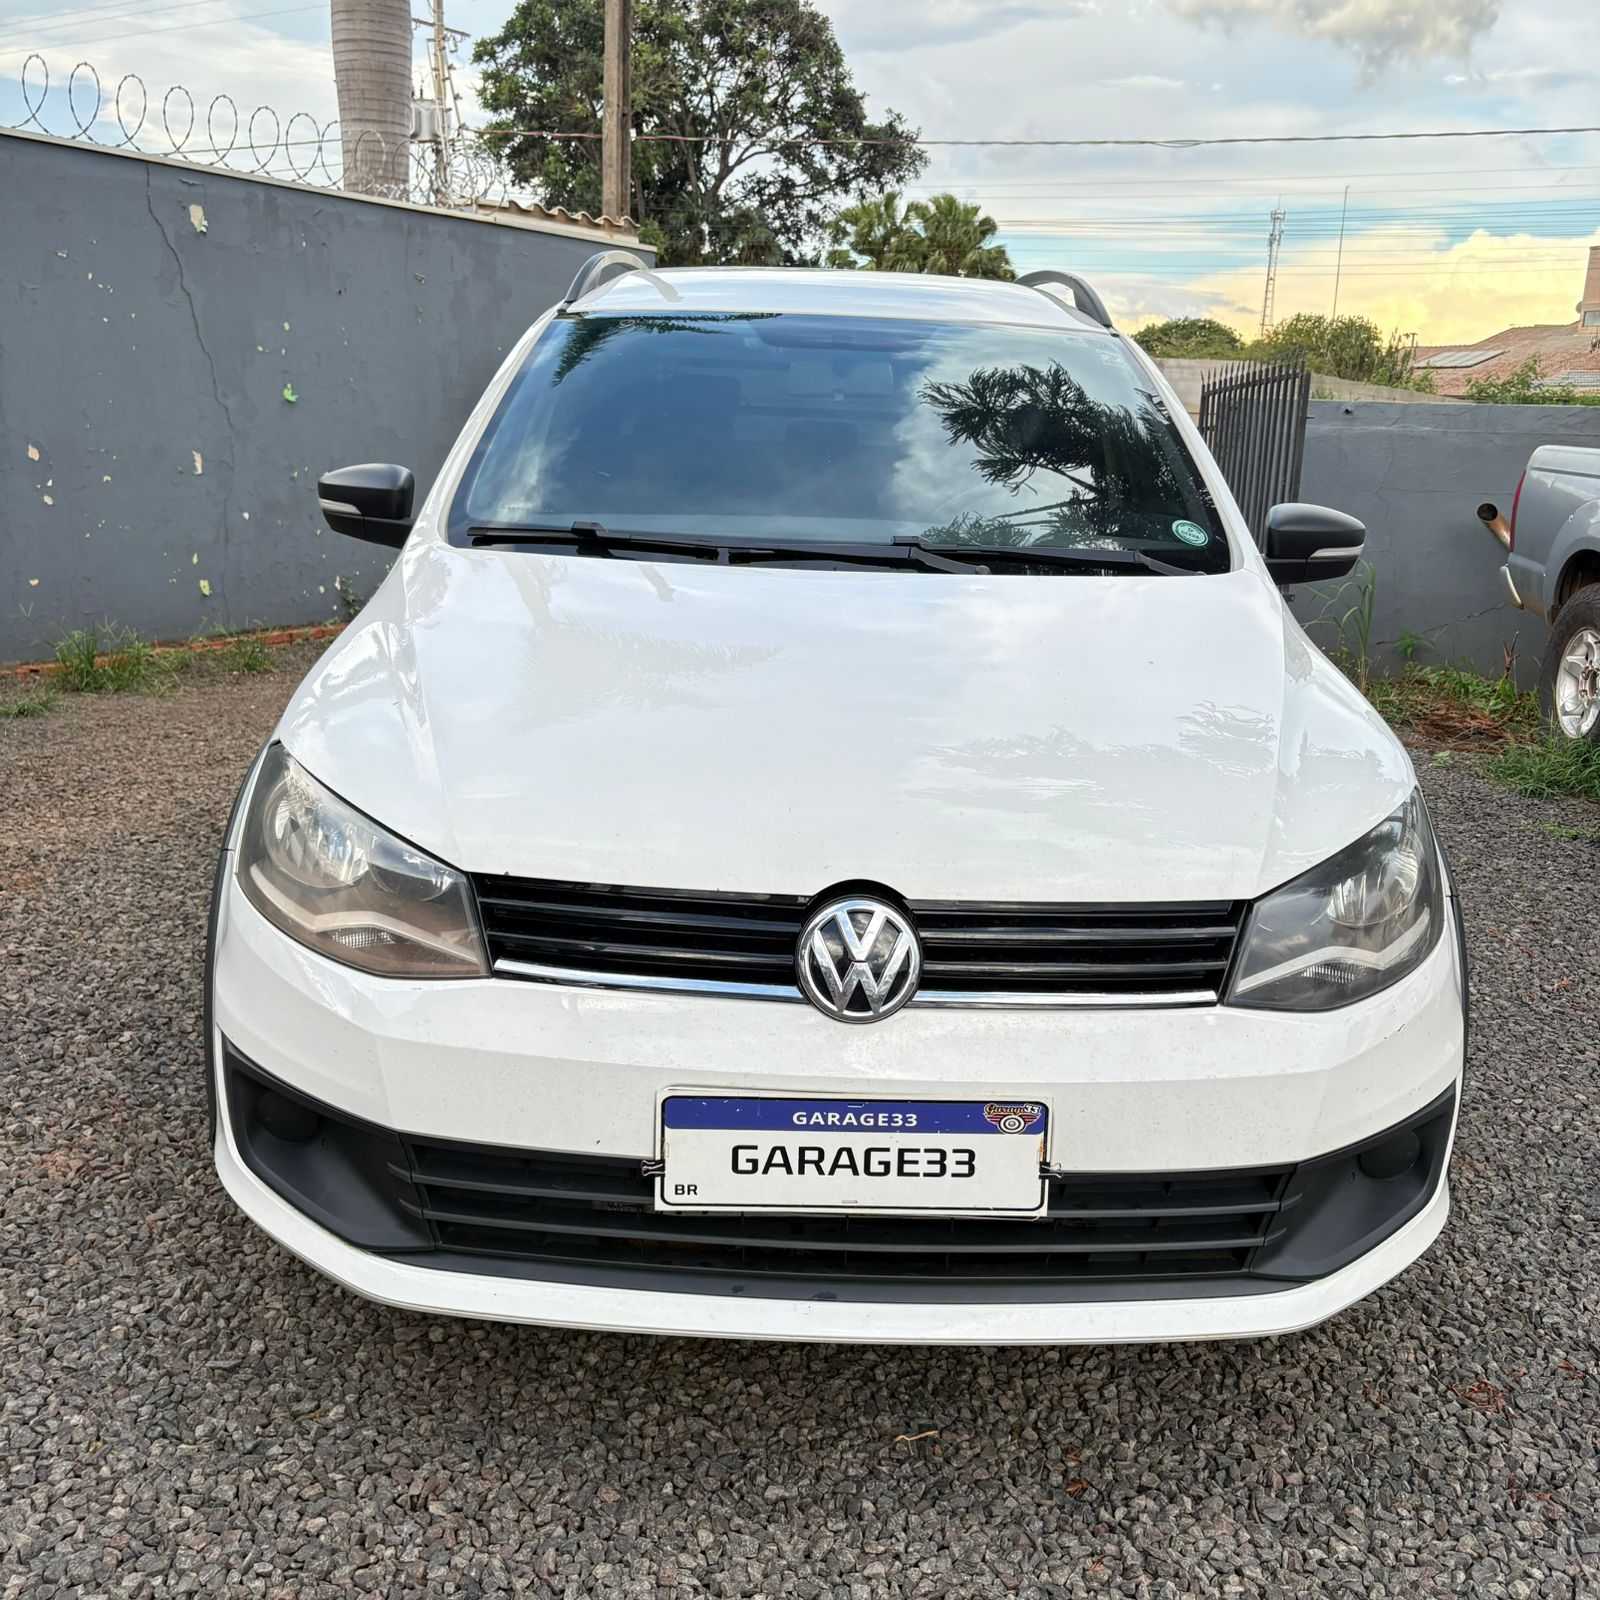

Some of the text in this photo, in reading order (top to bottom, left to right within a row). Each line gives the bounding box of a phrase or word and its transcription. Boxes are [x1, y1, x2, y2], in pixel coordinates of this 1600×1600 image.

[802, 902, 917, 1017] VW
[792, 1111, 918, 1128] GARAGE33
[731, 1144, 977, 1178] GARAGE33
[674, 1184, 698, 1196] BR
